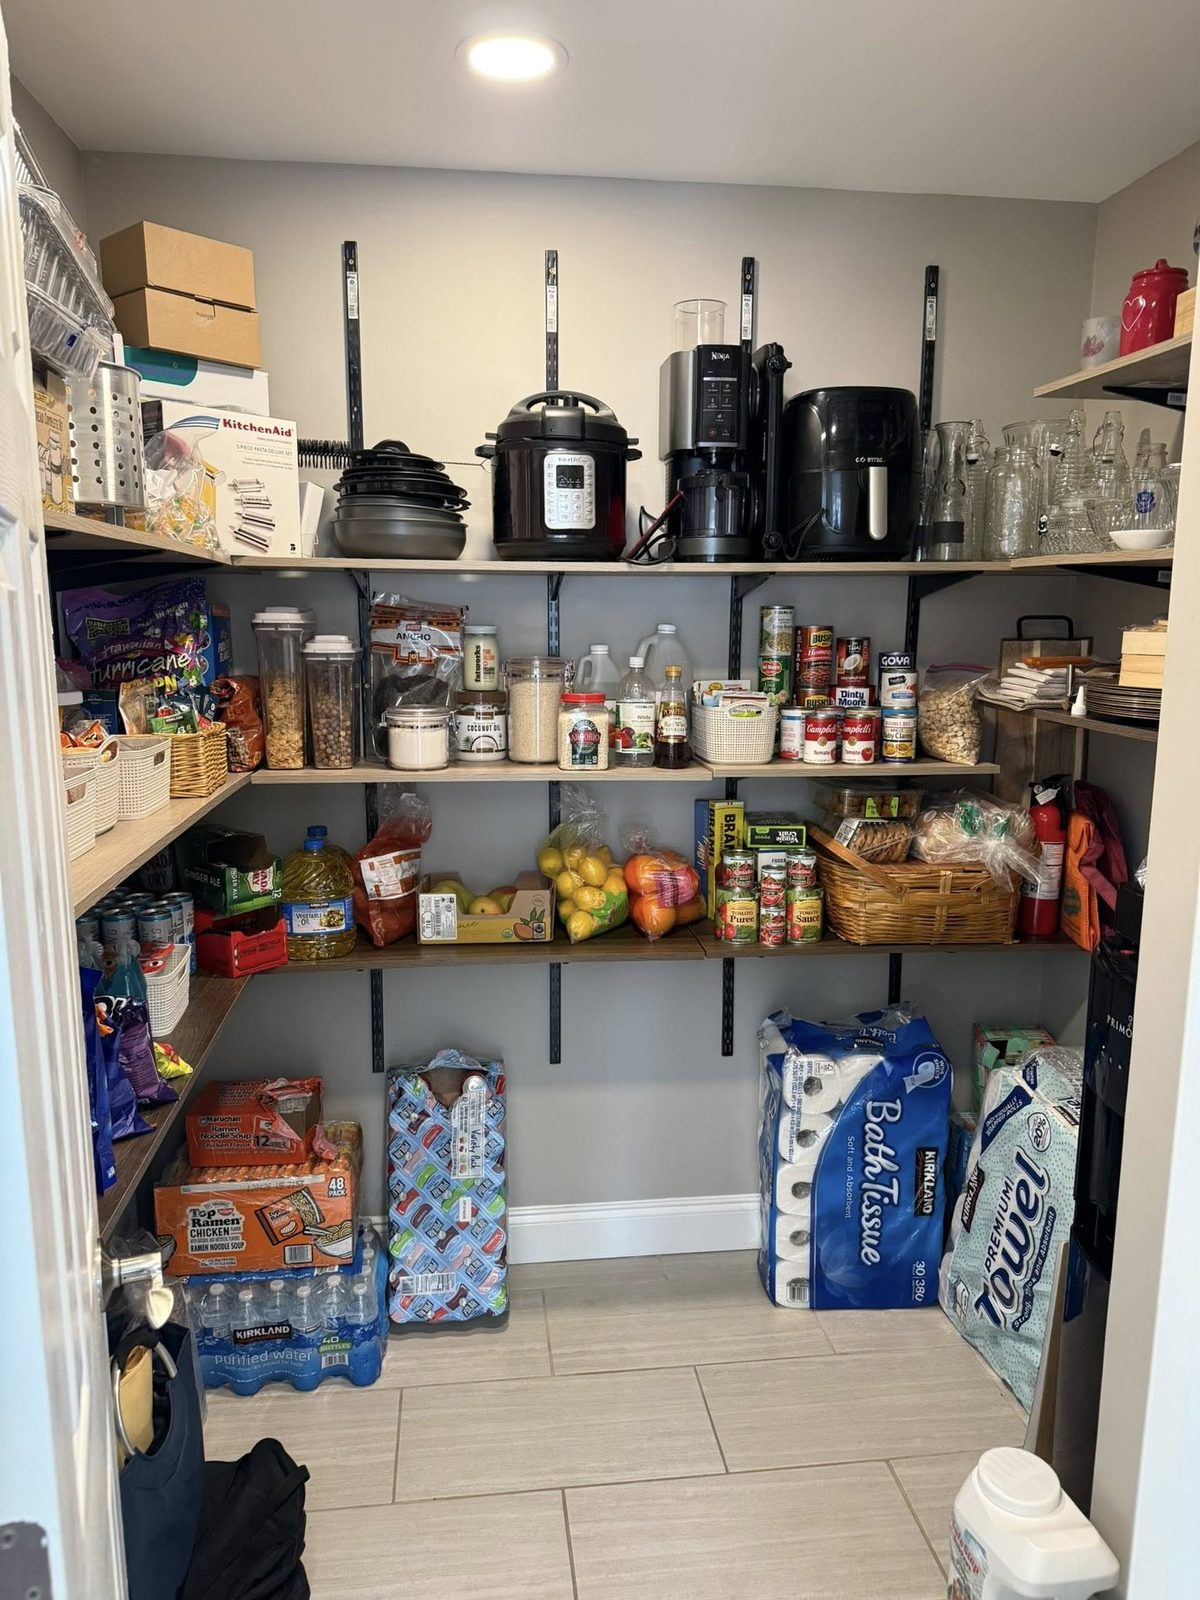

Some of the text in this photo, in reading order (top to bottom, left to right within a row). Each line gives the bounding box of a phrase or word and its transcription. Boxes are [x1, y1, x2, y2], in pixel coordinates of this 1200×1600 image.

[711, 351, 730, 361] NINJA
[222, 418, 292, 437] KitchenAid
[396, 632, 431, 641] ANCHO
[101, 640, 161, 658] Hawaiian
[881, 656, 910, 666] GOYA
[840, 690, 865, 699] Dinty
[838, 698, 867, 706] Moore
[776, 835, 799, 843] Veggie
[1106, 1014, 1133, 1038] PRIMO
[231, 1133, 252, 1141] Soup
[1033, 1118, 1046, 1148] 20%
[254, 1136, 271, 1147] 12
[329, 1177, 345, 1190] 48
[844, 1135, 856, 1219] Soft and Absorbent
[861, 1098, 902, 1266] Bath Tissue
[922, 1150, 937, 1215] KIRKLAND
[328, 1189, 346, 1197] PACK
[431, 1178, 450, 1198] POLAR
[190, 1208, 216, 1219] Top
[191, 1218, 240, 1228] Ramen
[985, 1176, 1015, 1273] PREMIUM
[190, 1227, 230, 1238] CHICKEN
[974, 1151, 1048, 1328] Towel
[1034, 1256, 1043, 1277] and
[1040, 1210, 1055, 1258] Absorbent
[191, 1244, 209, 1252] RAMEN
[210, 1243, 230, 1251] NOODLE
[915, 1260, 926, 1276] 30
[915, 1279, 926, 1302] 380
[236, 1326, 290, 1339] KIRKLAND
[214, 1349, 312, 1366] purified water
